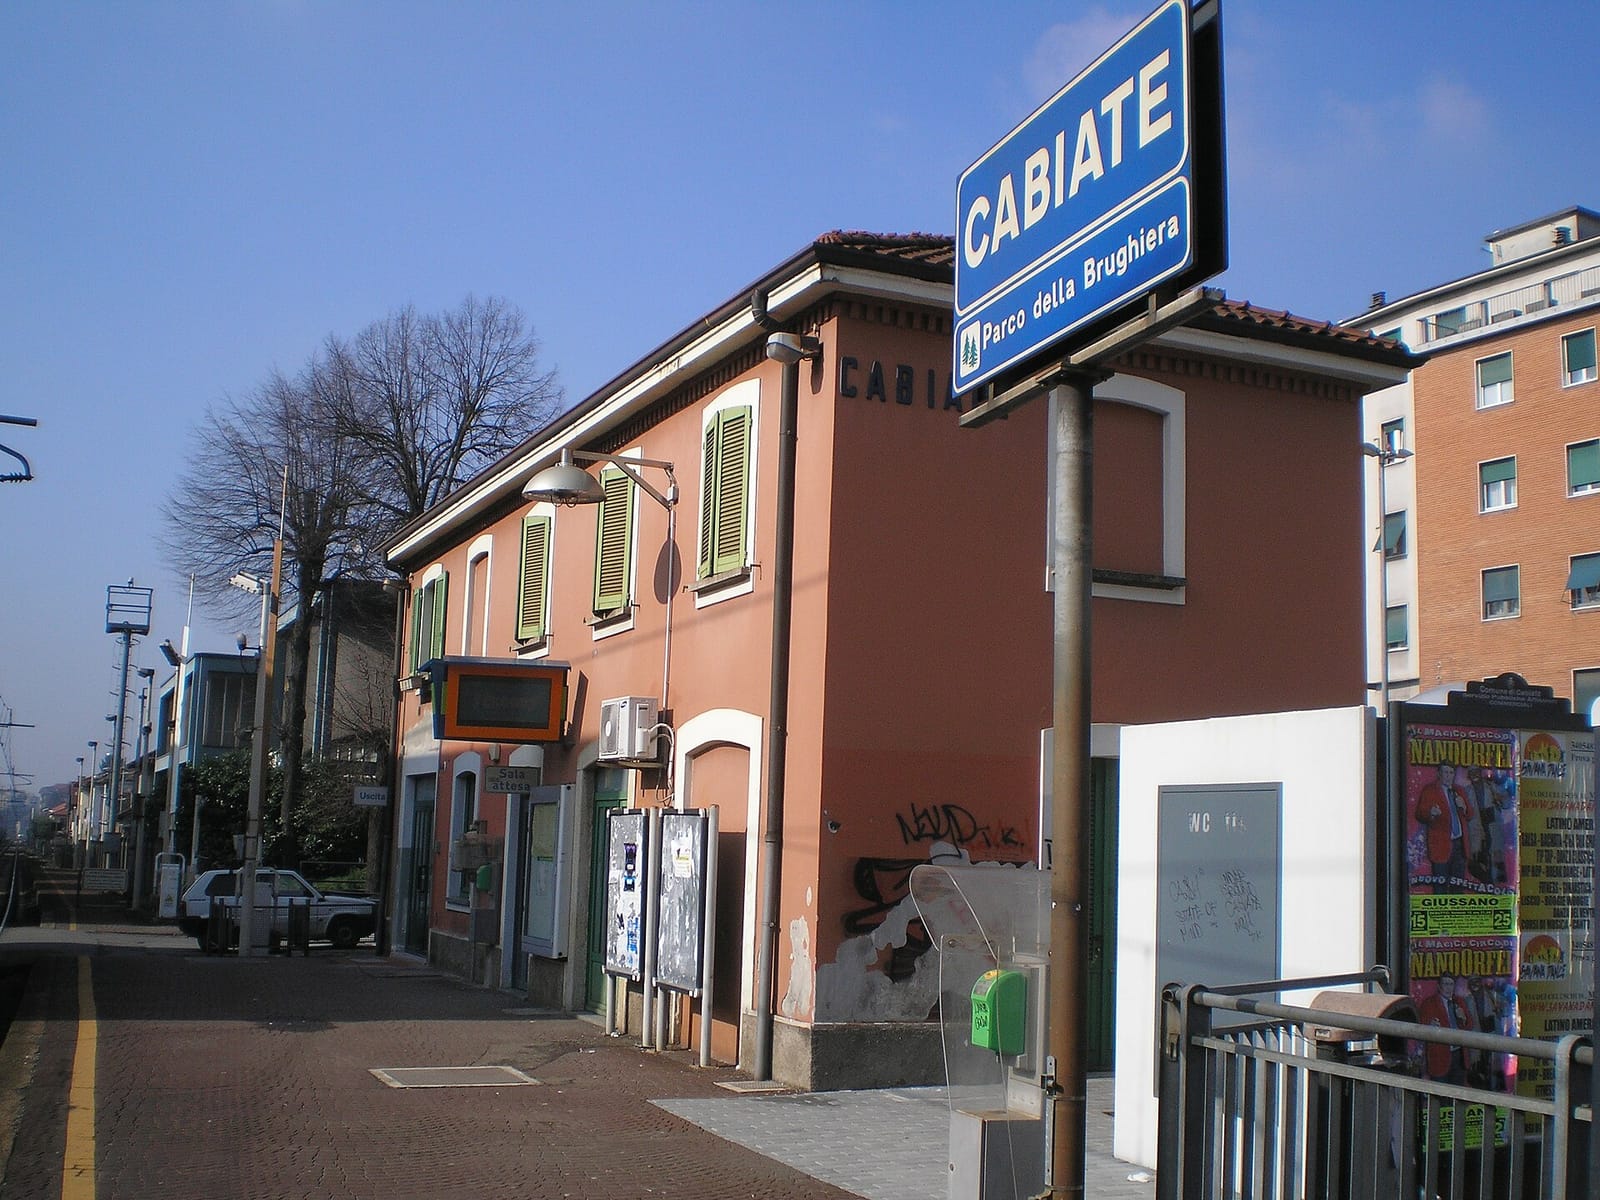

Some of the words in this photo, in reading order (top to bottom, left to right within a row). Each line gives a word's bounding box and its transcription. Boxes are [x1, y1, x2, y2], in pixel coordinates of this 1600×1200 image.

[964, 48, 1172, 268] CABIATE
[982, 311, 1025, 350] Parco
[1033, 280, 1074, 320] della
[1084, 214, 1179, 288] Brughiera
[1424, 729, 1466, 738] MAGICO
[500, 768, 525, 779] Sala
[492, 782, 530, 791] attesa
[359, 791, 386, 800] Uscita
[1188, 812, 1210, 832] WC
[1546, 817, 1571, 830] LATINO
[1422, 898, 1499, 907] GIUSSANO
[1411, 914, 1425, 927] 15
[1494, 913, 1511, 926] 25
[1424, 940, 1466, 949] MAGICO
[1469, 940, 1503, 948] CIRCO
